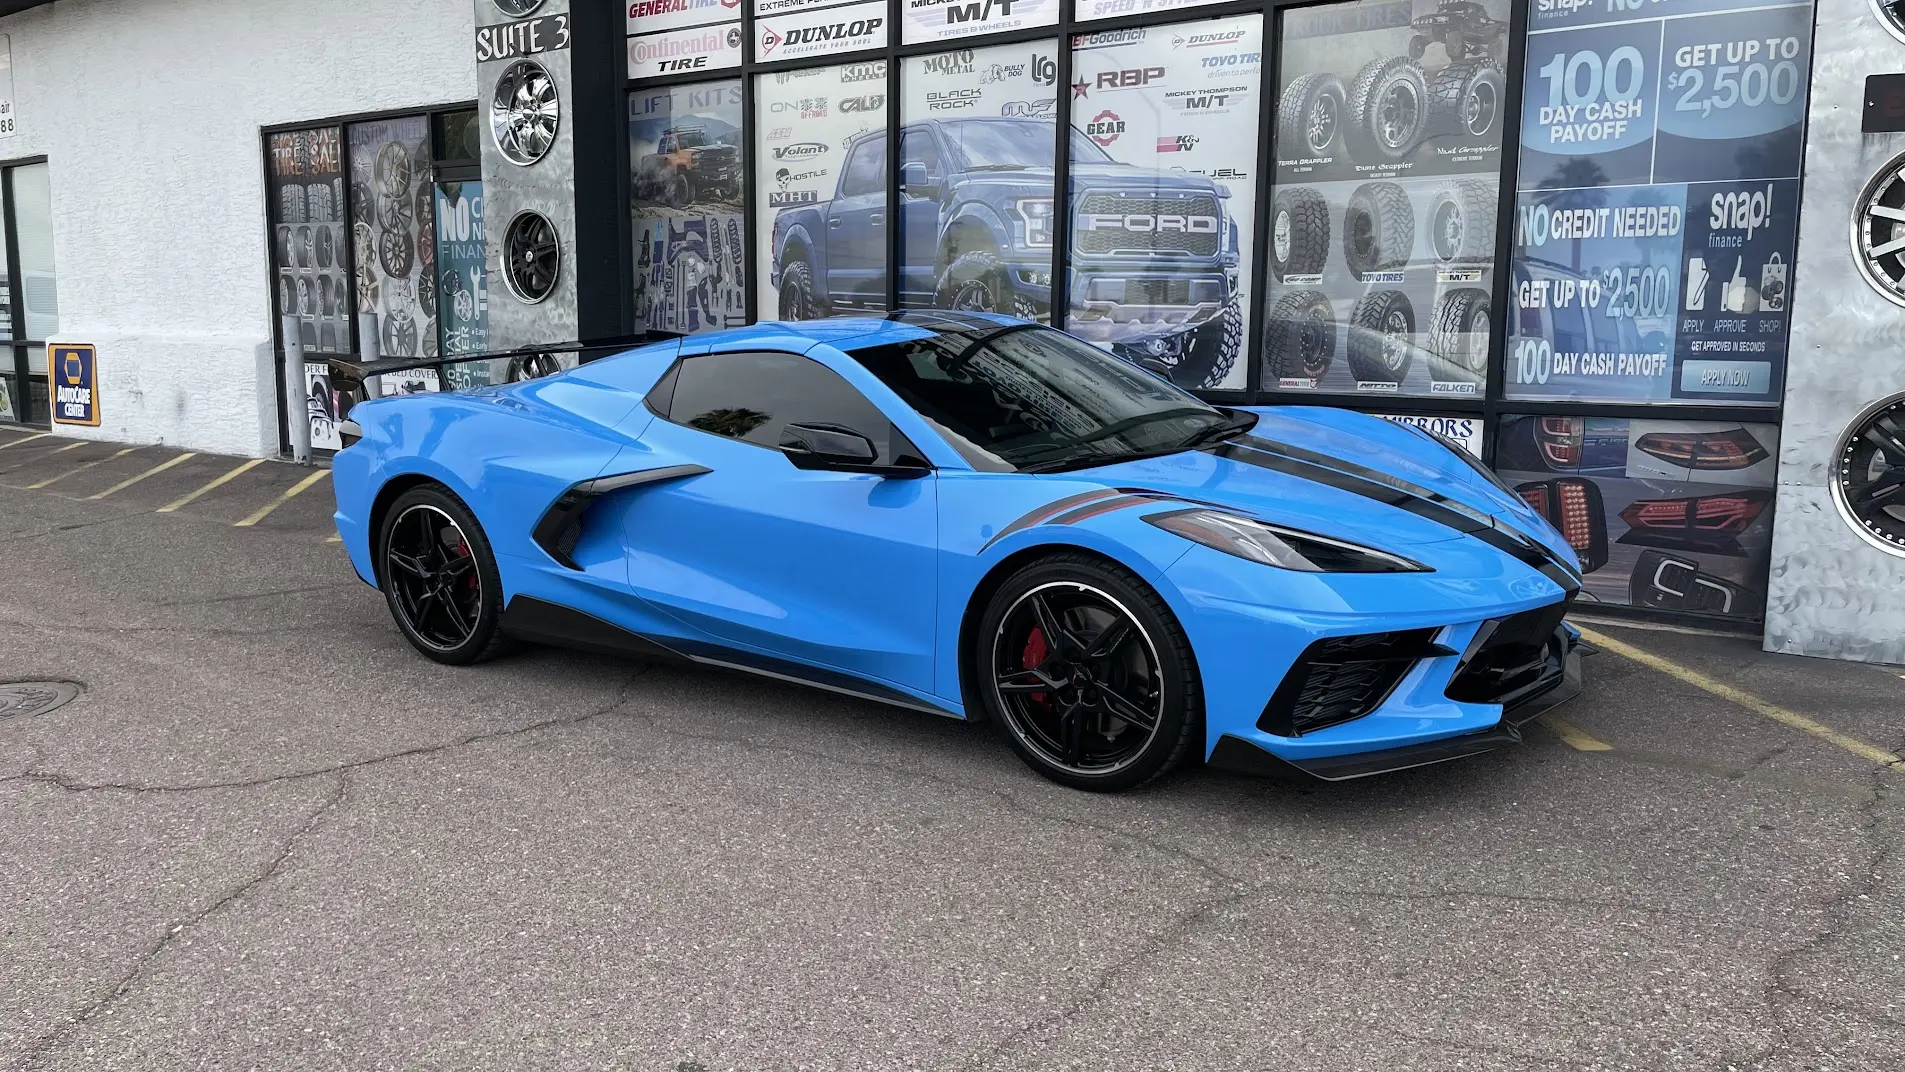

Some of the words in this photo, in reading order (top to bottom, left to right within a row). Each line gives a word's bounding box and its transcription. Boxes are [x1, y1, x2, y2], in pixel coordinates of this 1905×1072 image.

[947, 0, 1019, 24] M/T
[1094, 0, 1135, 15] SPEED
[1538, 10, 1568, 19] finance
[783, 18, 883, 46] DUNLOP
[937, 27, 968, 37] TIRES
[979, 20, 1021, 32] WHEELS
[477, 20, 544, 61] SUITE
[555, 16, 569, 49] 3
[1072, 29, 1147, 47] BFGoodrich
[1187, 31, 1246, 44] DUNLOP
[630, 30, 724, 65] Continental
[783, 43, 827, 54] ACCELERATE
[1675, 43, 1722, 69] GET
[1727, 39, 1759, 64] UP
[1766, 36, 1800, 60] TO
[658, 56, 708, 71] TIRE
[923, 48, 975, 75] MOTO
[1004, 64, 1026, 72] BULLY
[1201, 54, 1237, 67] TOYO
[942, 64, 975, 75] METAL
[1008, 70, 1022, 78] DOG
[1097, 66, 1165, 89] RBP
[1540, 46, 1644, 109] 100
[927, 88, 982, 100] BLACK
[1165, 90, 1197, 98] MICKEY
[1198, 86, 1248, 95] THOMPSON
[1667, 61, 1799, 119] $2,500
[631, 94, 679, 116] LIFT
[689, 86, 742, 109] KITS
[929, 99, 974, 111] ROCK
[1186, 95, 1230, 109] M/T
[1539, 104, 1577, 125] DAY
[1585, 99, 1643, 121] CASH
[350, 123, 388, 147] CUSTOM
[1087, 121, 1125, 135] GEAR
[1550, 121, 1628, 144] PAYOFF
[773, 146, 825, 159] Volant
[1299, 157, 1333, 166] GRAPPLER
[1378, 161, 1414, 170] Grappler
[790, 169, 828, 181] HOSTILE
[772, 191, 814, 204] MHT
[440, 197, 470, 242] NO
[1710, 183, 1773, 241] snap!
[1089, 214, 1218, 233] FORD
[1518, 203, 1549, 247] NO
[1551, 207, 1610, 240] CREDIT
[1613, 205, 1681, 238] NEEDED
[1708, 232, 1743, 248] finance
[1362, 273, 1381, 283] TOYO
[1381, 272, 1404, 282] TIRES
[1519, 280, 1550, 309] GET
[1553, 280, 1575, 309] UP
[1579, 279, 1600, 308] TO
[1603, 266, 1671, 321] $2,500
[1682, 319, 1704, 333] APPLY
[1714, 319, 1747, 333] APPROVE
[1691, 341, 1702, 352] GET
[1703, 341, 1732, 352] APPROVED
[1739, 341, 1766, 352] SECONDS
[1515, 340, 1550, 385] 100
[1553, 352, 1578, 376] DAY
[1581, 352, 1614, 376] CASH
[1618, 353, 1667, 377] PAYOFF
[1701, 368, 1727, 387] APPLY
[1727, 369, 1750, 387] NOW
[1432, 384, 1474, 393] FALKEN
[65, 402, 84, 417] CENTER
